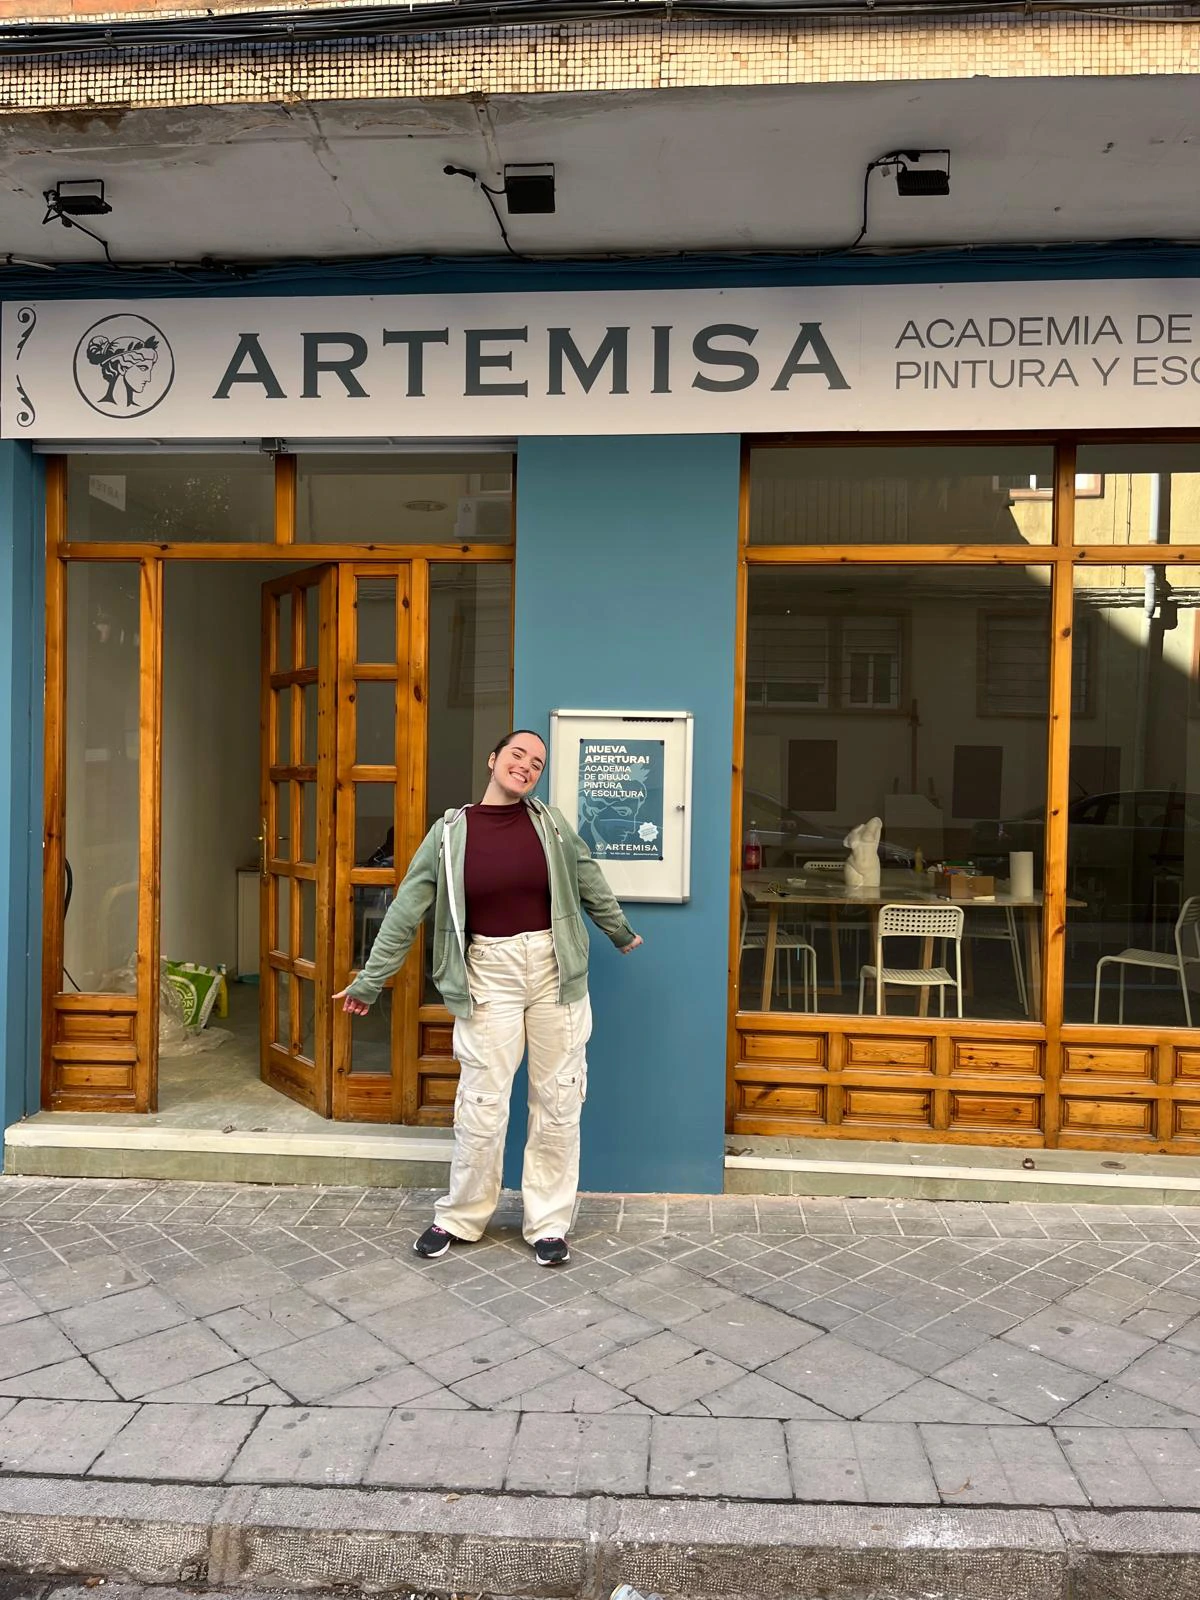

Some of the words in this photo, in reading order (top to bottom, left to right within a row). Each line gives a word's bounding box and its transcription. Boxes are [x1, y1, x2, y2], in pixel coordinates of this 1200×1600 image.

[895, 315, 1124, 349] ACADEMIA
[1136, 314, 1193, 344] DE
[212, 322, 851, 399] ARTEMISA
[895, 358, 1080, 390] PINTURA
[1091, 357, 1121, 387] Y
[585, 745, 627, 754] ¡NUEVA
[584, 755, 650, 764] APERTURA!
[584, 765, 632, 773] ACADEMIA
[584, 773, 597, 781] DE
[583, 781, 623, 789] PINTURA
[583, 789, 590, 797] Y
[591, 790, 645, 798] ESCULTURA
[605, 843, 659, 852] ARTEMISA
